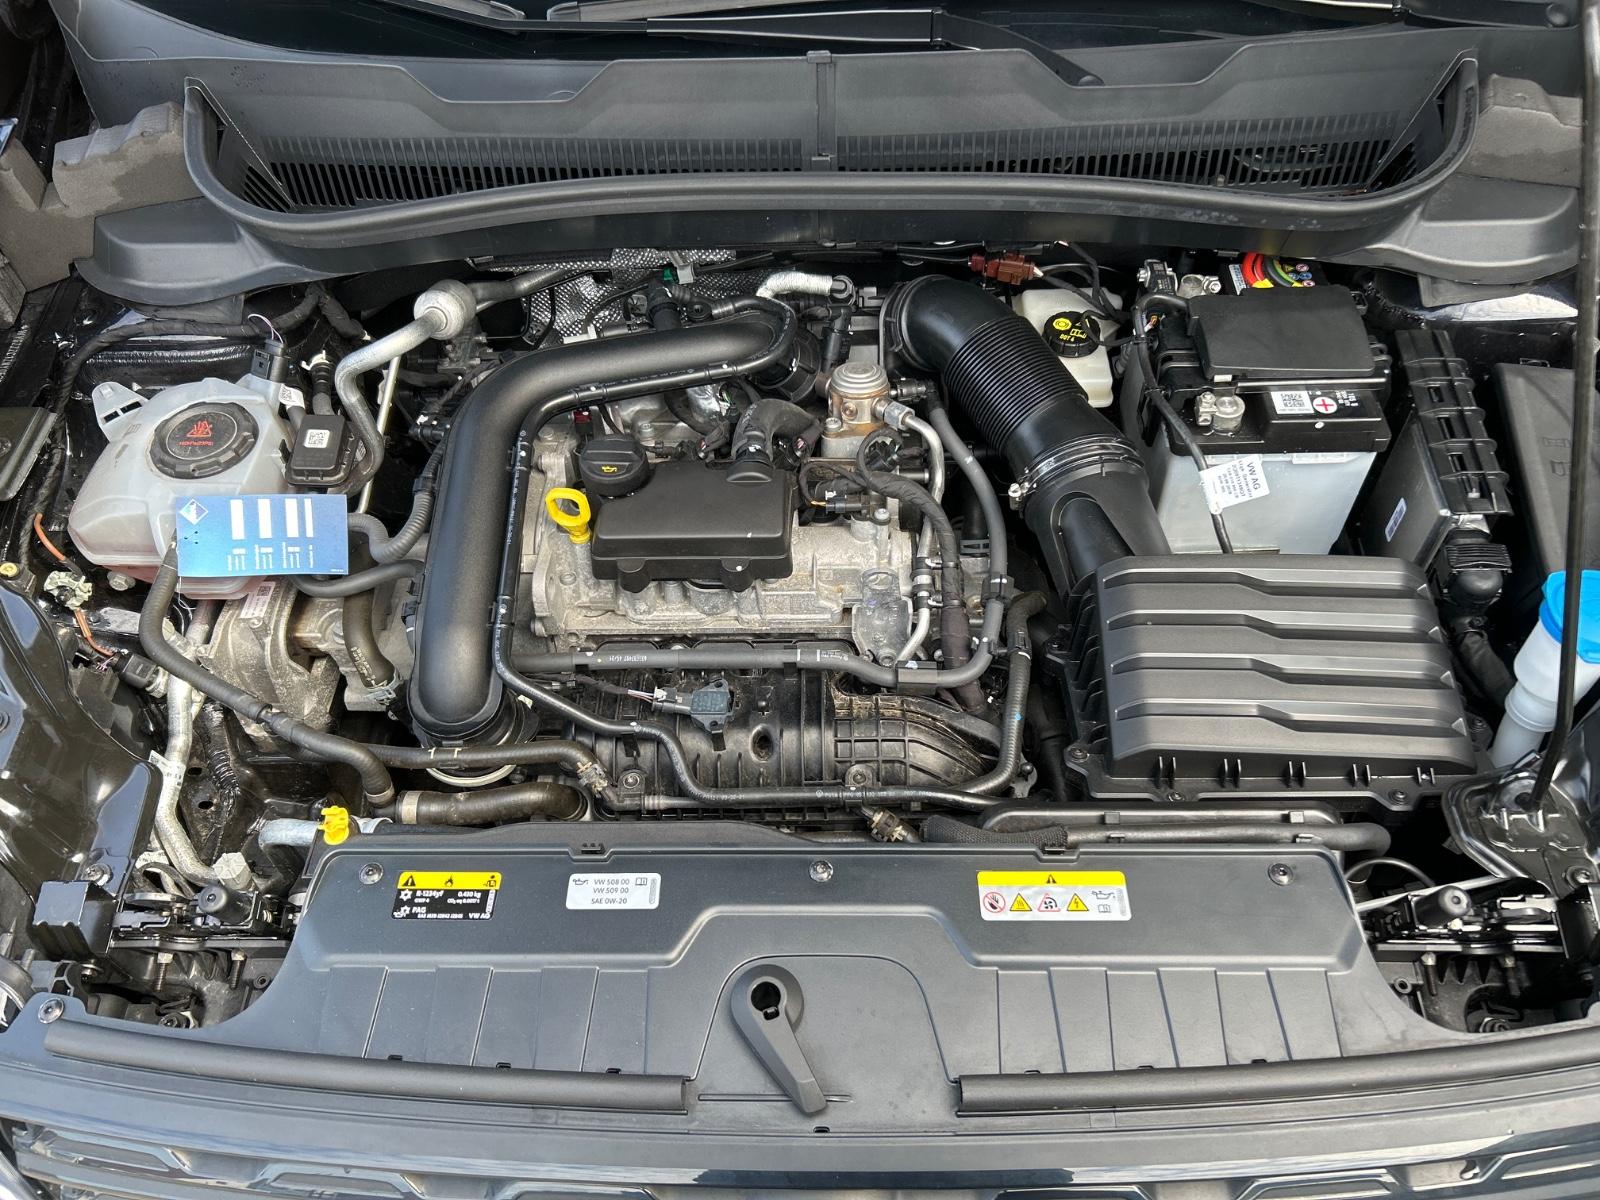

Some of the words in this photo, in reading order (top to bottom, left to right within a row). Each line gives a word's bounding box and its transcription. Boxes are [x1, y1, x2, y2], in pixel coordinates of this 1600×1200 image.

[1247, 461, 1257, 476] VW
[1251, 478, 1261, 490] AG
[416, 890, 444, 898] R-1234yf
